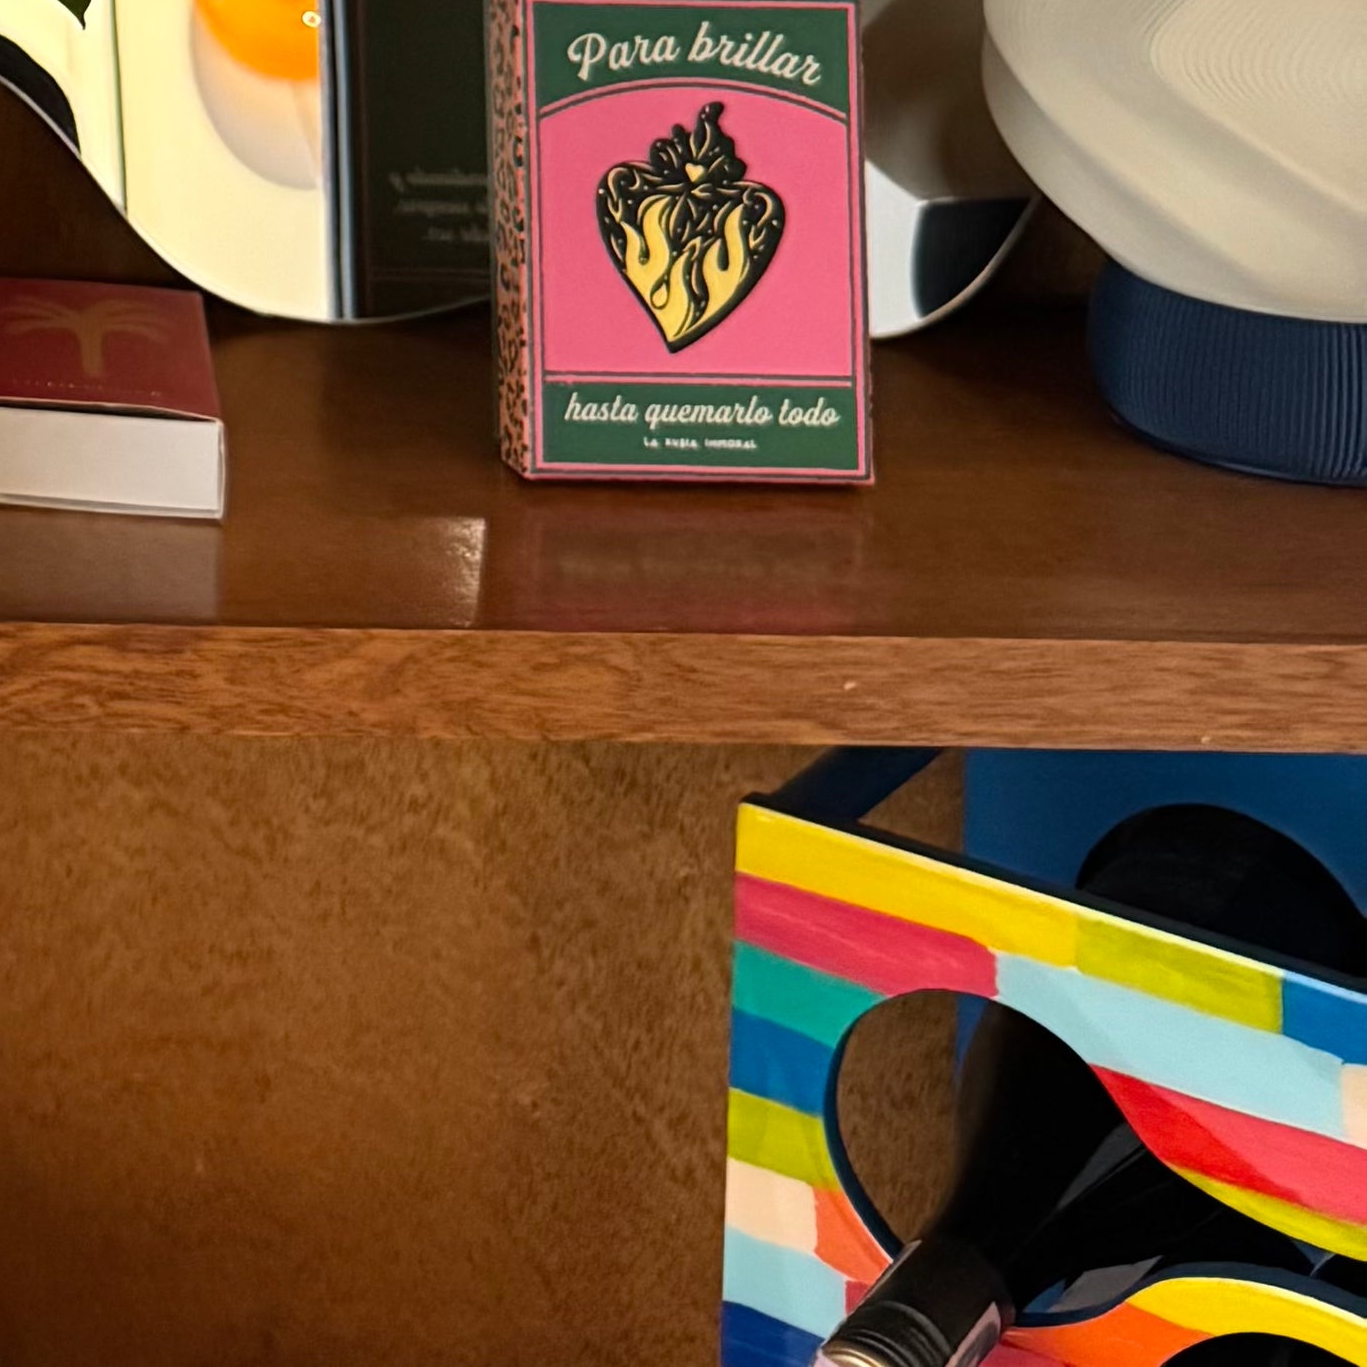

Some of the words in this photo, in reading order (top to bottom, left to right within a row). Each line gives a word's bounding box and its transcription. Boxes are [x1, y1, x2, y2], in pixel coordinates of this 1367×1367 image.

[568, 33, 680, 80] Para
[688, 22, 822, 86] brillar
[564, 392, 639, 423] hasta
[644, 391, 772, 431] quemarlo
[777, 396, 840, 426] todo
[643, 437, 659, 449] LA
